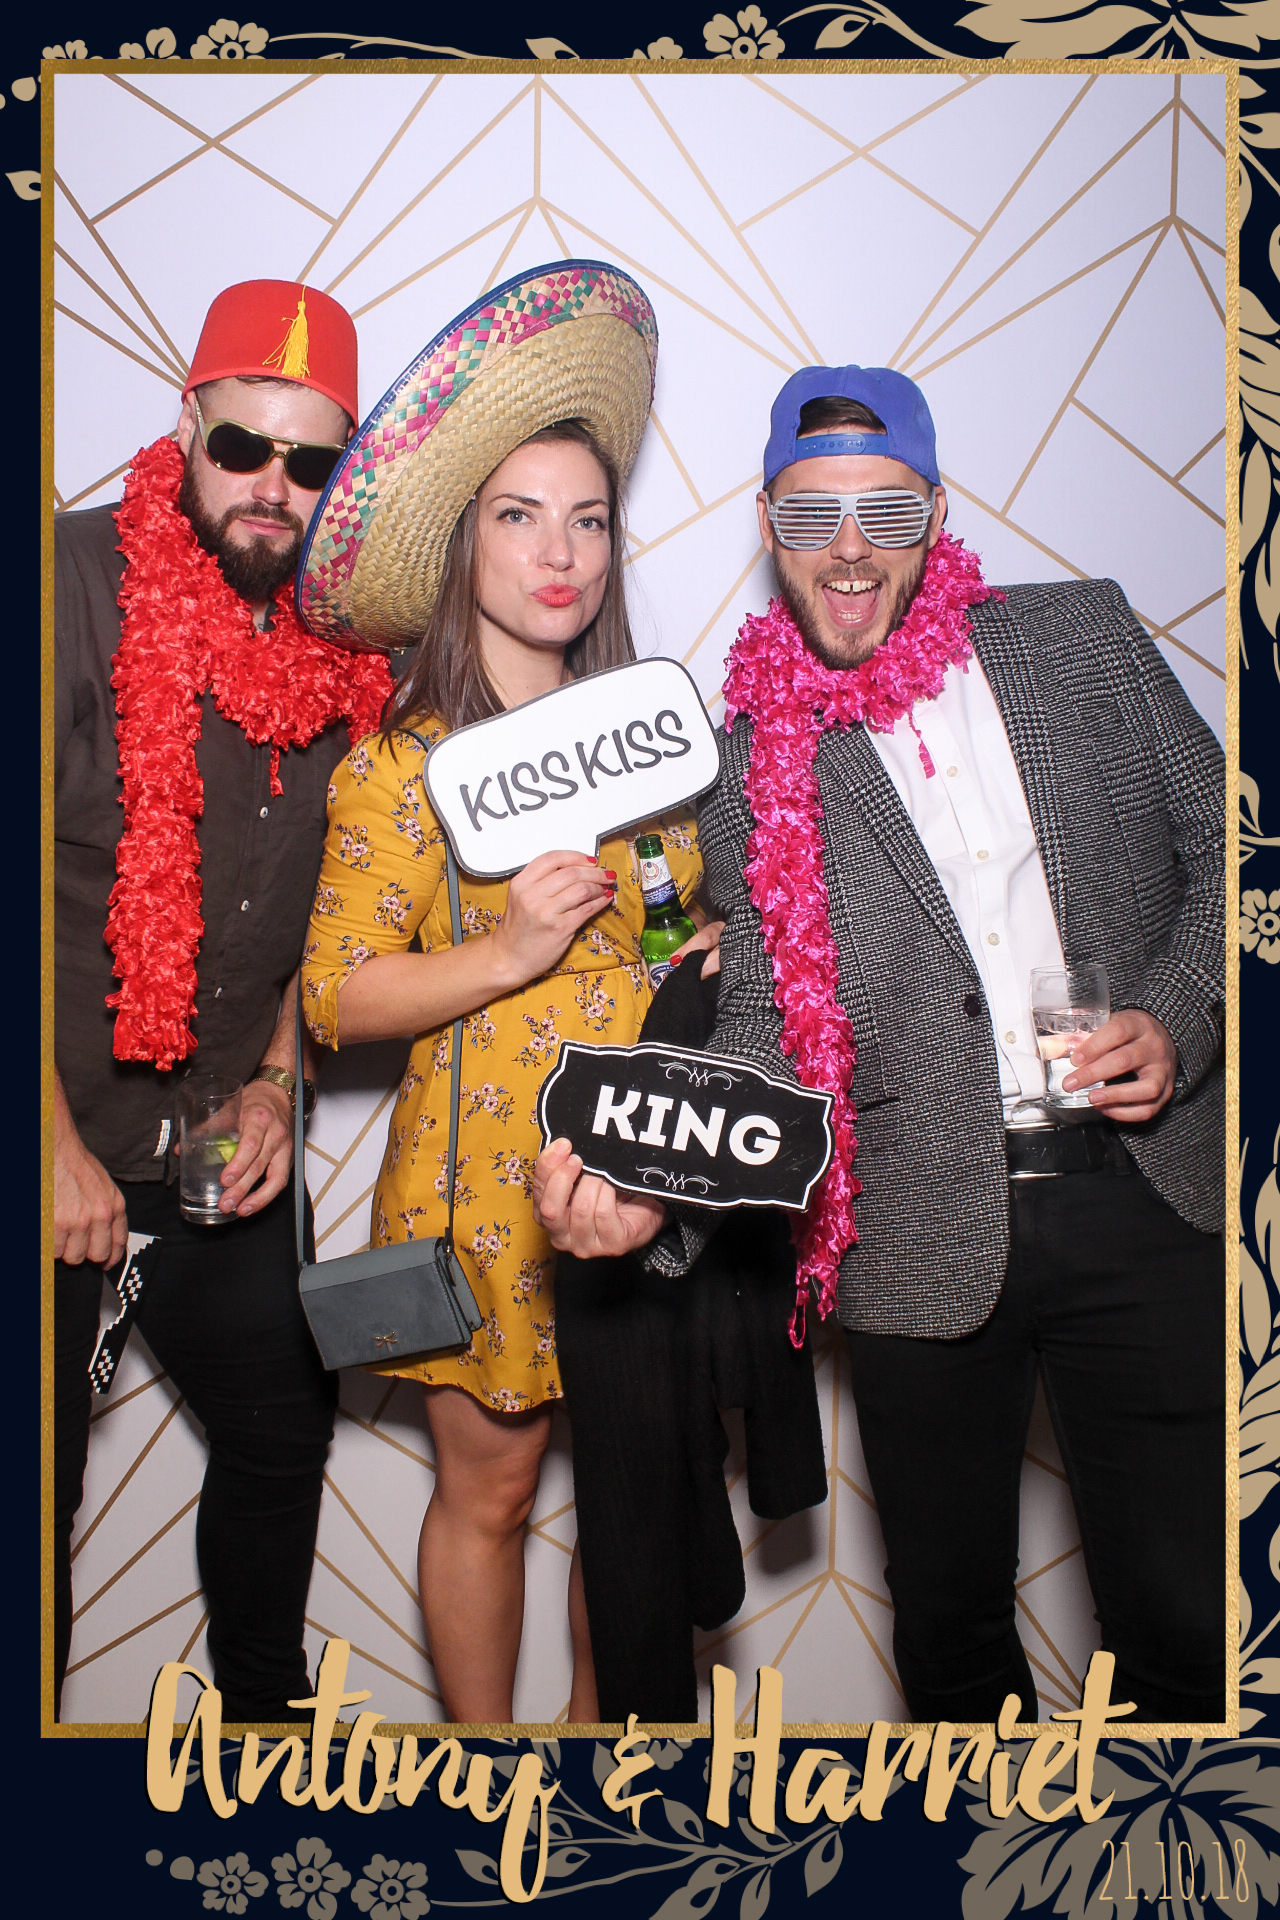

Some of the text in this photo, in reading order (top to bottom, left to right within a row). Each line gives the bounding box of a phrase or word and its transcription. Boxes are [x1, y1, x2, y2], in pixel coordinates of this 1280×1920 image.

[459, 710, 691, 832] KISS KISS
[592, 1084, 781, 1165] KING
